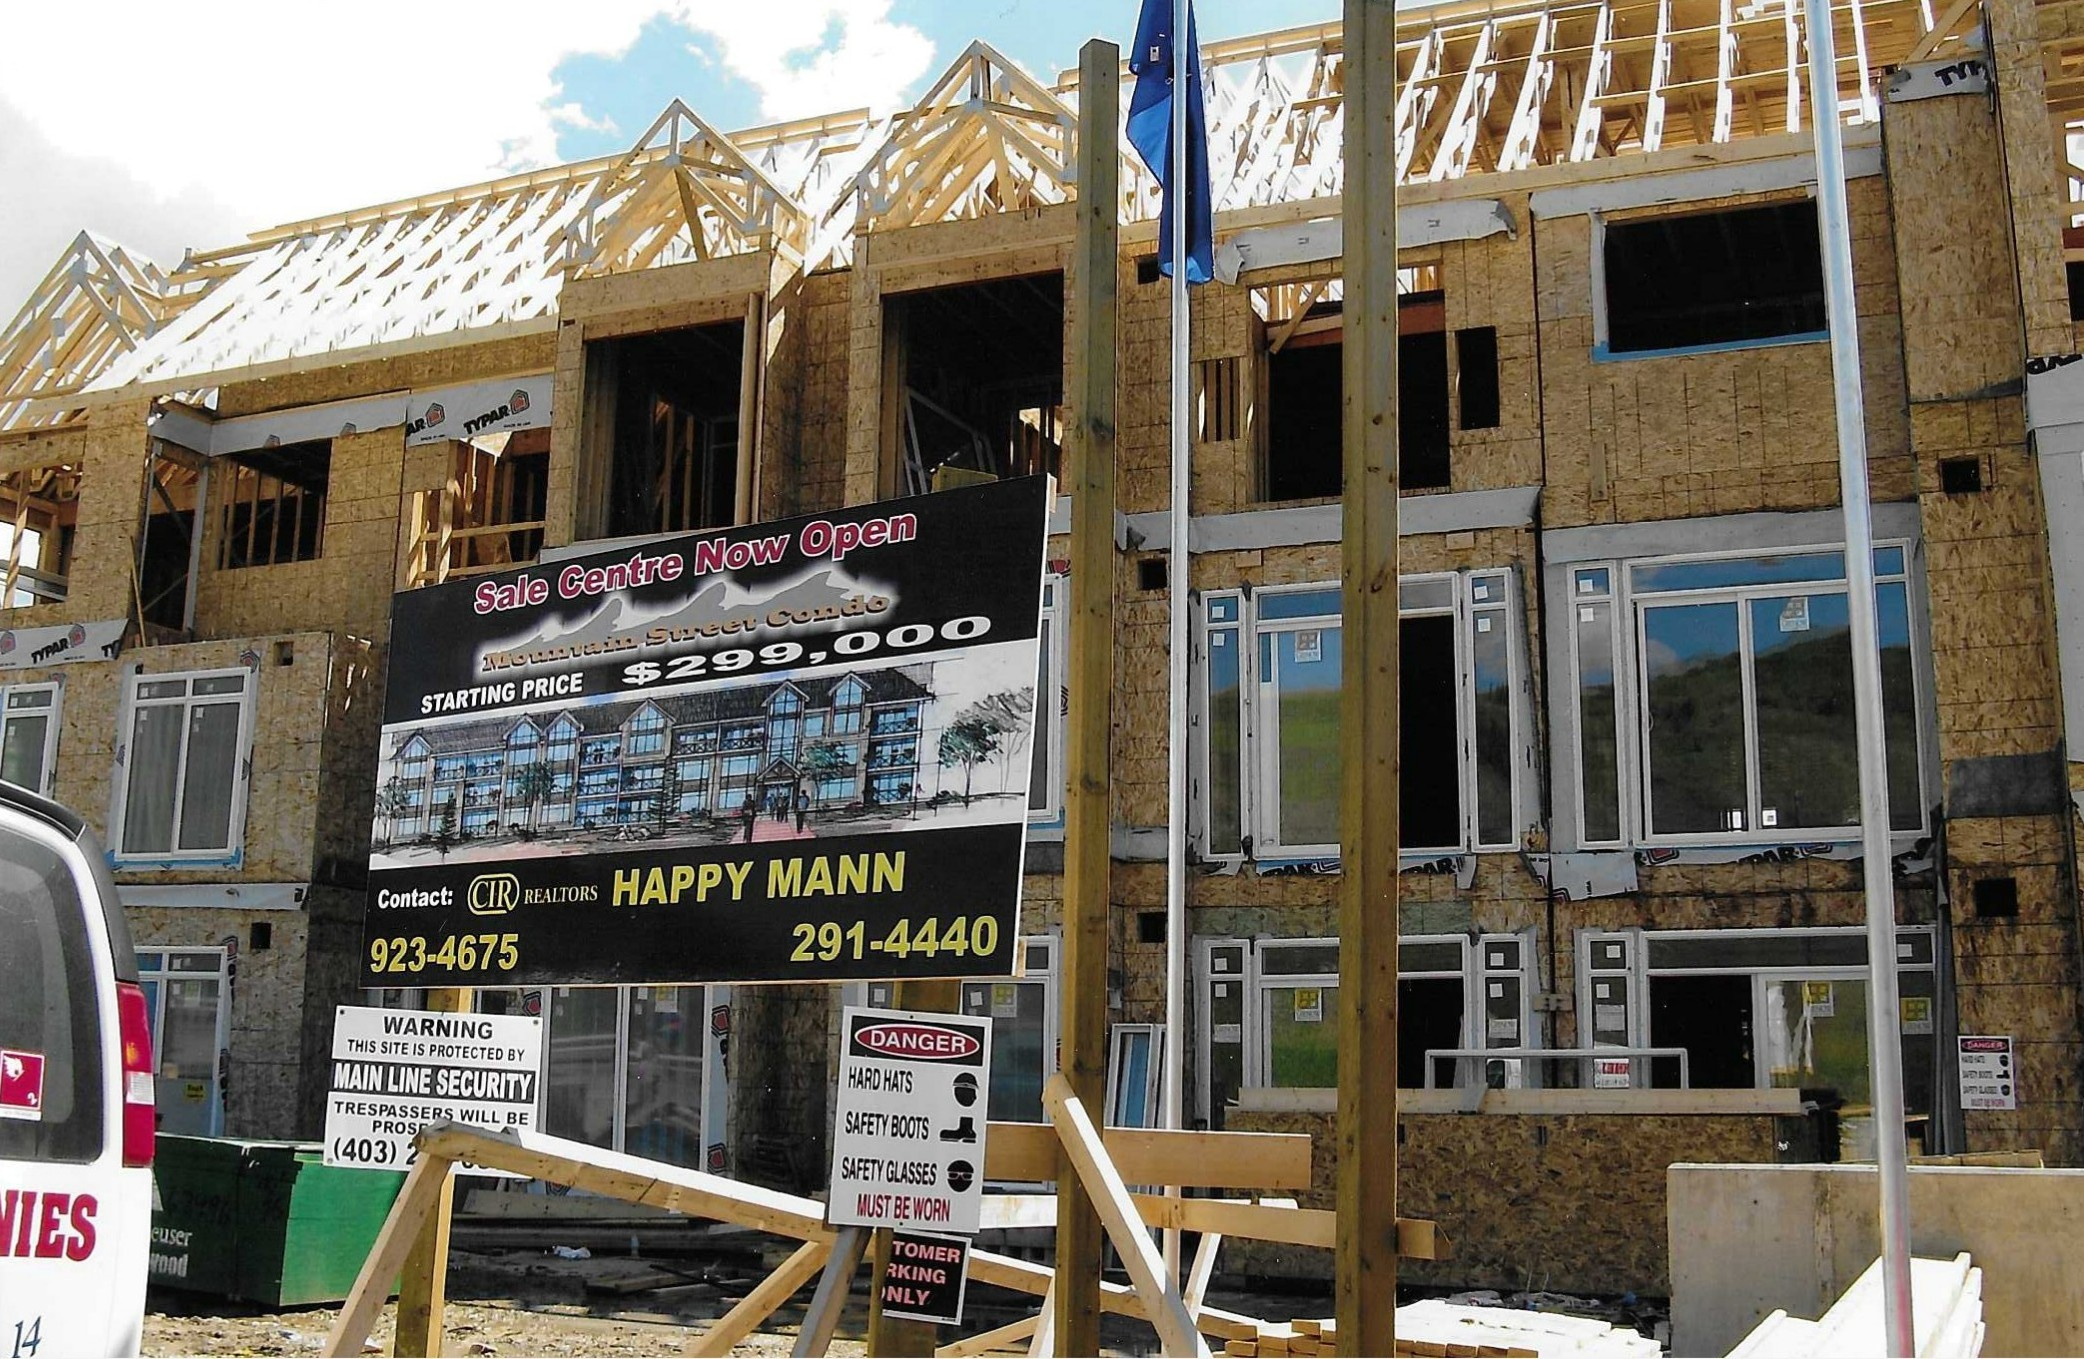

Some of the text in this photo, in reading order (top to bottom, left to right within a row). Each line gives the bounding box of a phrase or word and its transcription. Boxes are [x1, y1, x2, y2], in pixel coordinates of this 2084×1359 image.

[463, 404, 510, 434] TYPAR
[474, 513, 917, 614] Sale Centre Now Open
[482, 594, 890, 672] Mountain Street Condo
[31, 637, 69, 664] TYPAR
[421, 615, 992, 714] STARTING PRICE $299,000
[378, 886, 453, 909] Contact:
[524, 885, 598, 904] REALTORS
[612, 861, 754, 907] HAPPY
[767, 851, 906, 899] MANN
[370, 915, 999, 973] 923-4675 291-4440
[383, 1015, 493, 1040] WARNING
[870, 1029, 966, 1053] DANGER
[347, 1039, 525, 1062] THIS SITE IS PROTECTED BY
[334, 1062, 532, 1101] MAIN LINE SECURITY
[848, 1066, 913, 1094] HARD HATS
[334, 1101, 529, 1126] TRESPASSERS WILL BE
[845, 1111, 929, 1140] SAFETY BOOTS
[334, 1137, 397, 1165] (403)
[841, 1156, 937, 1186] SAFETY GLASSES
[857, 1193, 951, 1222] MUST BE WORN
[151, 1226, 193, 1247] euser
[892, 1240, 961, 1263] TOMER
[881, 1285, 931, 1306] NLY
[11, 1315, 42, 1359] 14
